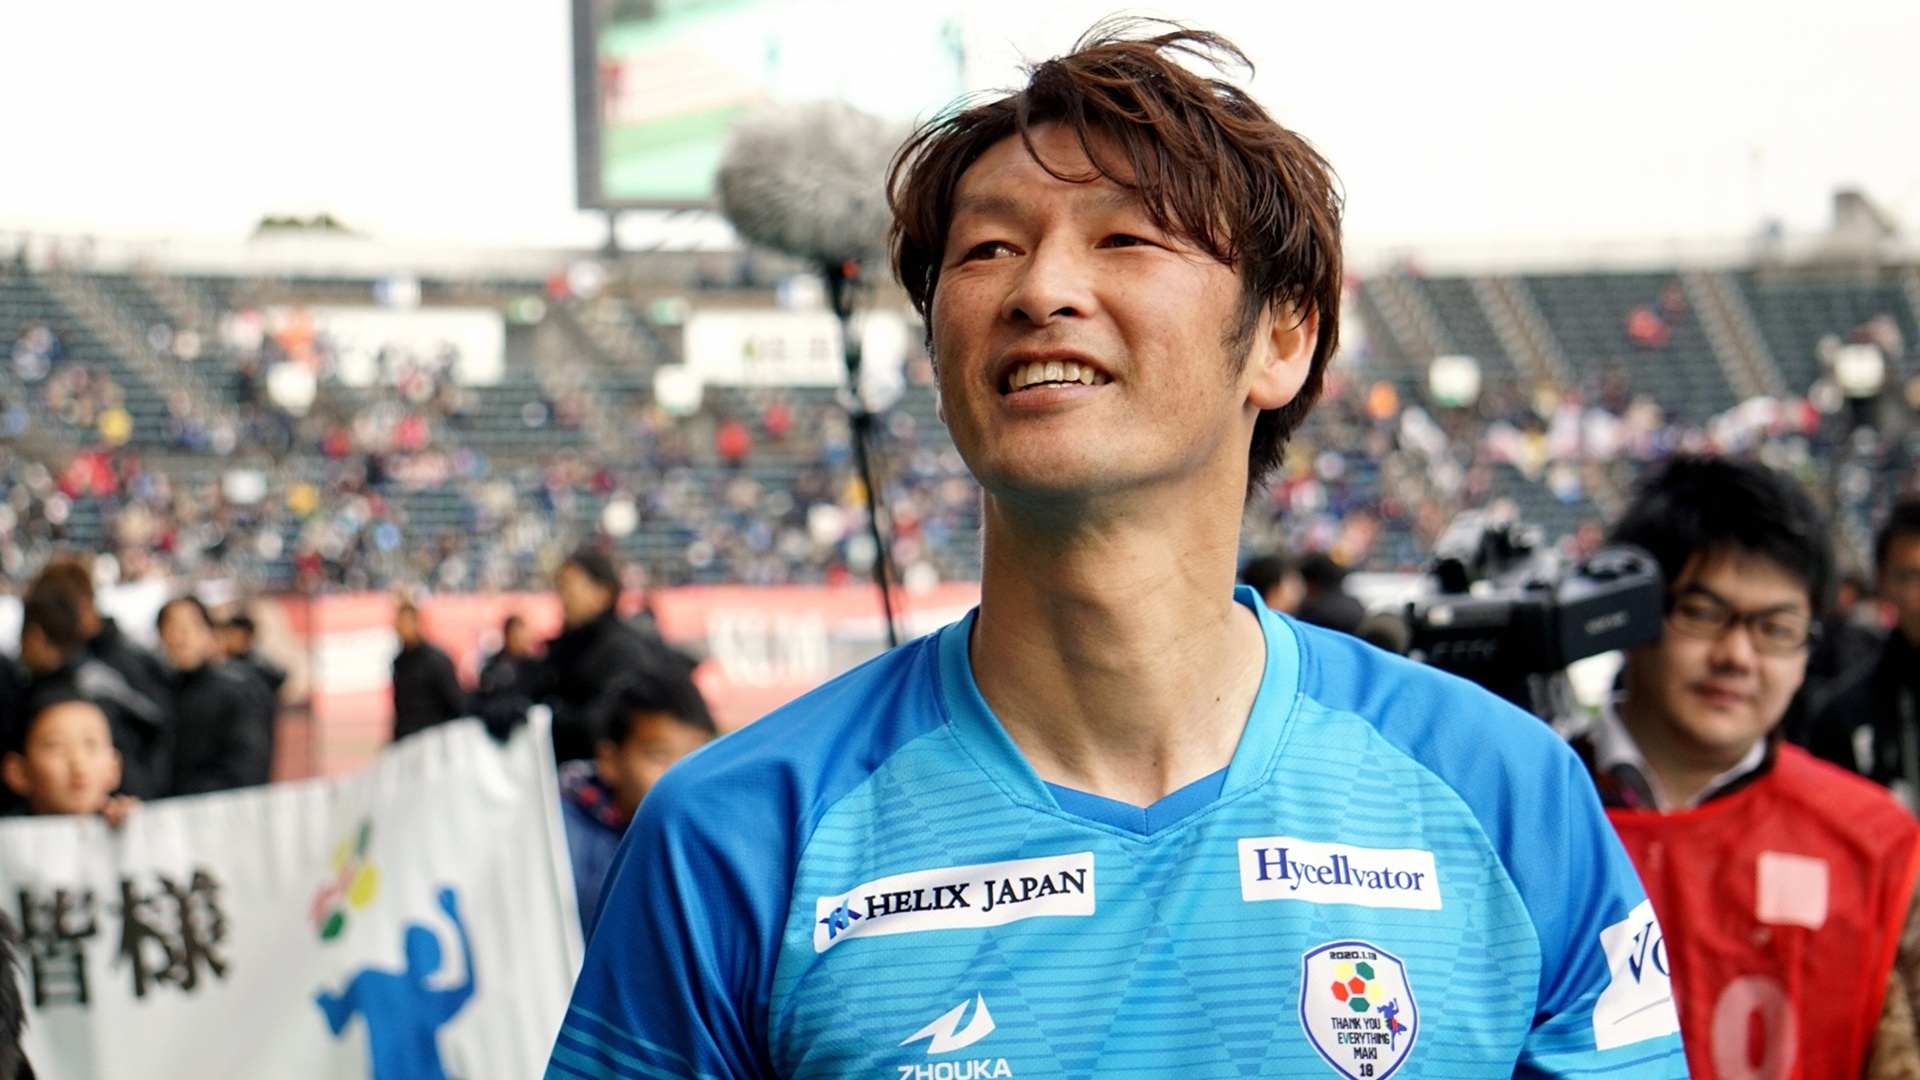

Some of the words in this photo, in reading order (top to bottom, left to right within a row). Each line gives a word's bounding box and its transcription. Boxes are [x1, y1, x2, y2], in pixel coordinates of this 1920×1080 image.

[1254, 847, 1425, 892] Hycellvator
[865, 883, 970, 920] HELIX
[981, 868, 1087, 912] JAPAN
[17, 866, 227, 1007] 皆様
[1329, 950, 1378, 961] 2020.1.13
[1331, 1017, 1361, 1030] THANK
[1362, 1017, 1382, 1030] YOU
[1338, 1032, 1391, 1045] EVERYTHING
[1353, 1047, 1378, 1060] MAKI
[897, 1058, 1013, 1080] ZHOUKA
[1359, 1063, 1374, 1077] 18
